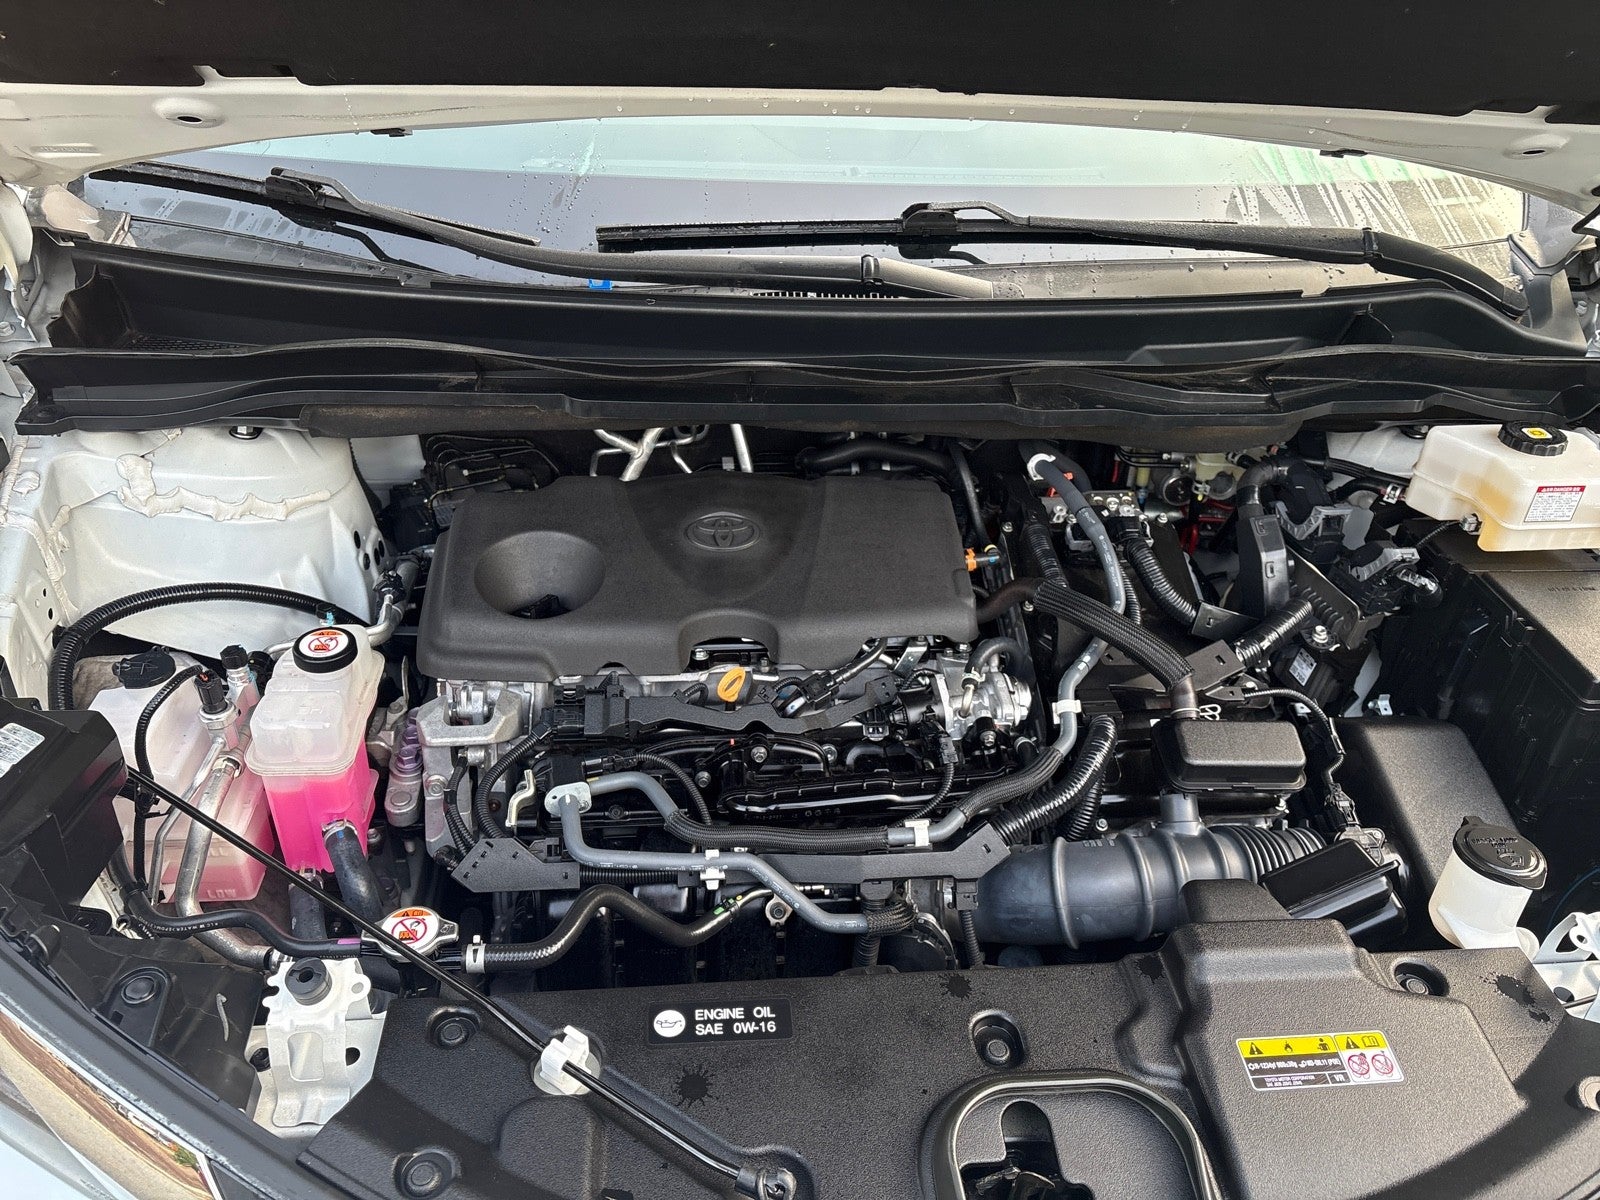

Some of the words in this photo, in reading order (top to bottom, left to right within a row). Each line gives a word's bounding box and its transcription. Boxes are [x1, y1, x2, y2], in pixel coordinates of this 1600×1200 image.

[206, 889, 237, 898] LOW
[695, 1008, 744, 1020] ENGINE
[753, 1006, 775, 1018] OIL
[695, 1023, 723, 1035] SAE
[733, 1021, 776, 1034] 0W-16
